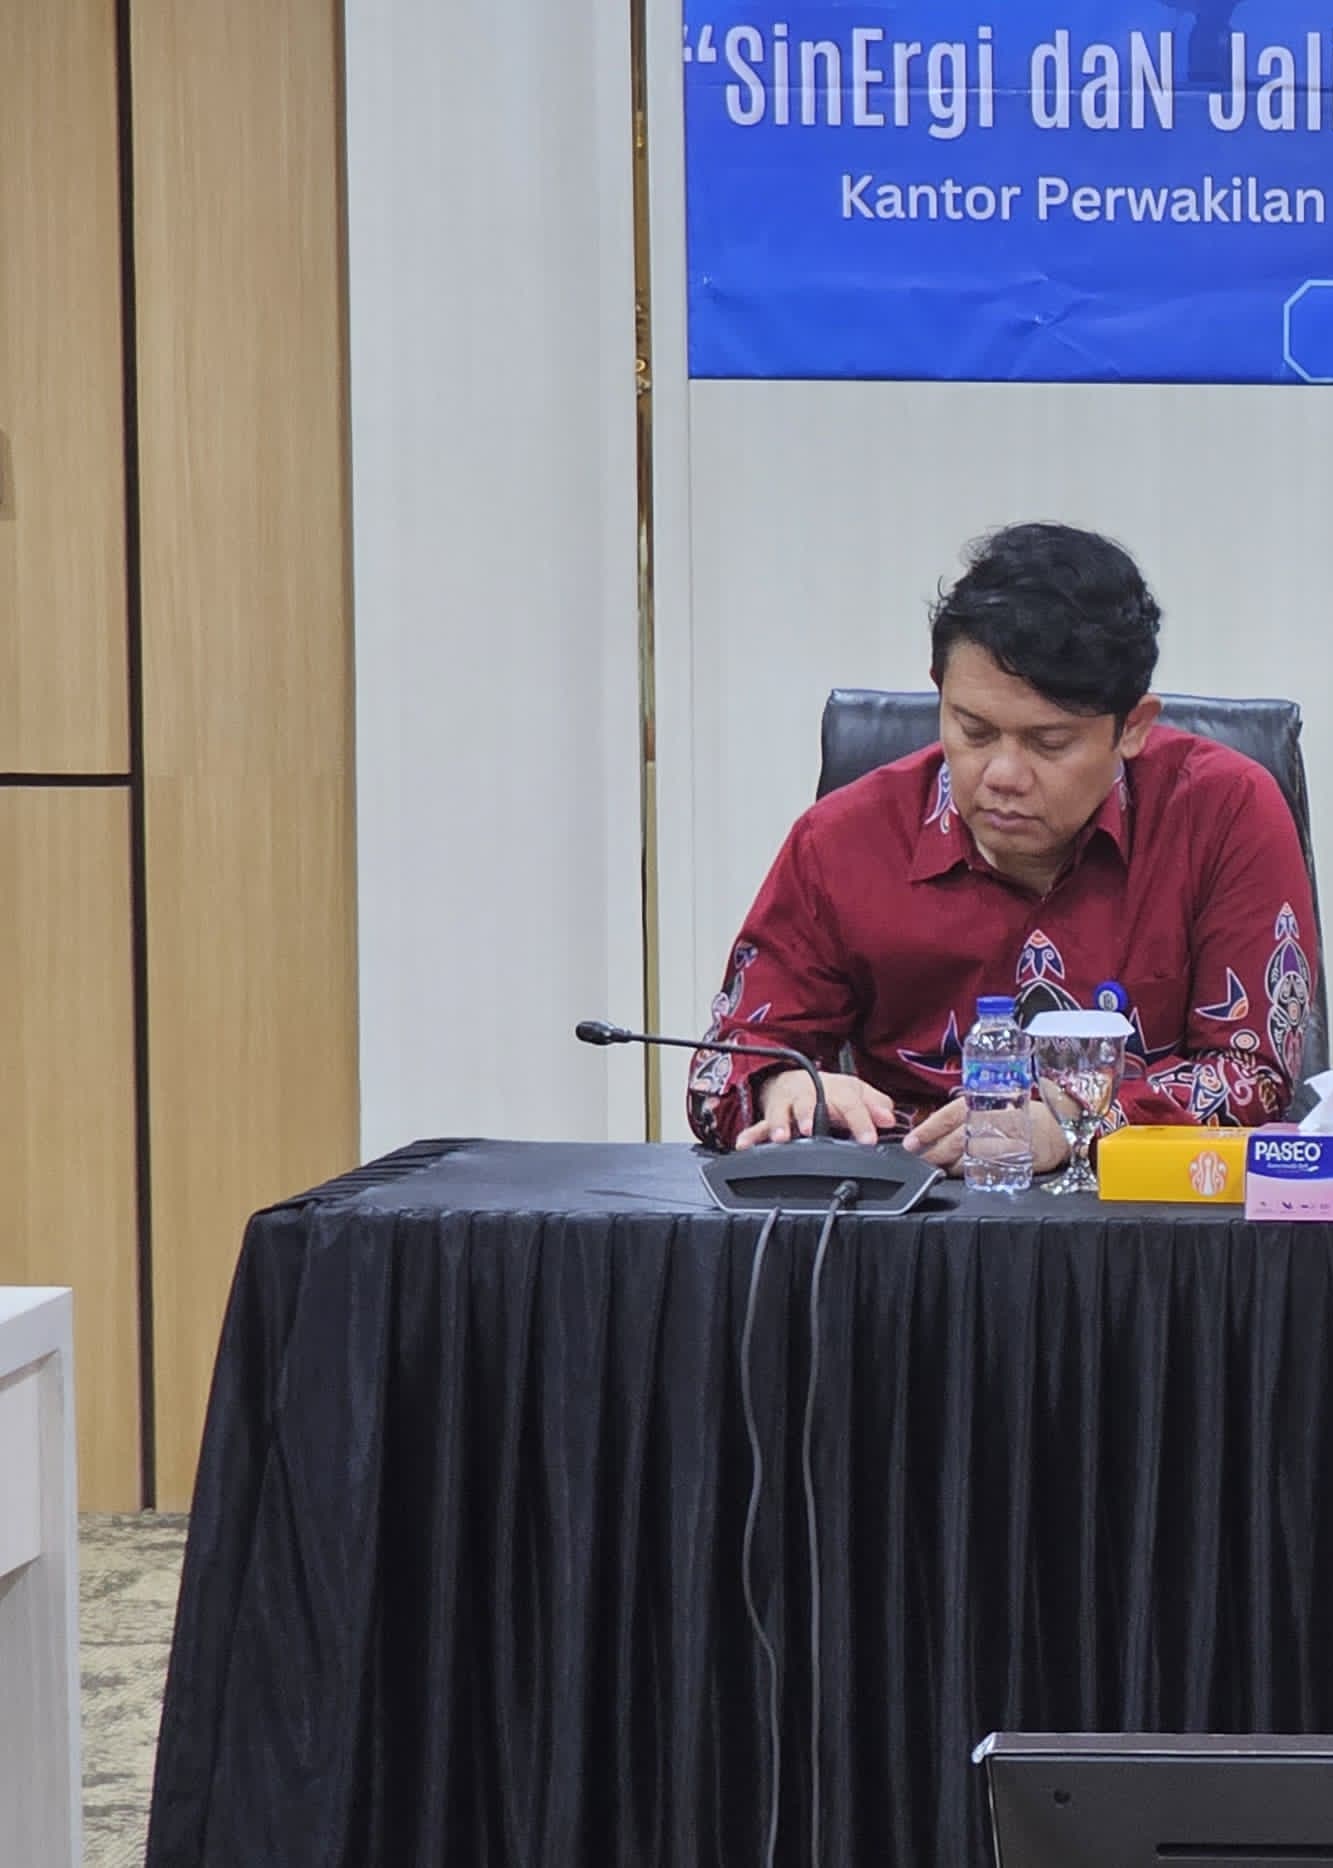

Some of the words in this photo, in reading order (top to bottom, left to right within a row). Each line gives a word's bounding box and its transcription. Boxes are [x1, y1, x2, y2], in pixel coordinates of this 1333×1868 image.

[1030, 30, 1174, 130] daN
[843, 175, 1021, 220] Kantor
[1038, 177, 1324, 225] Perwakilan
[1255, 1141, 1321, 1162] PASEO
